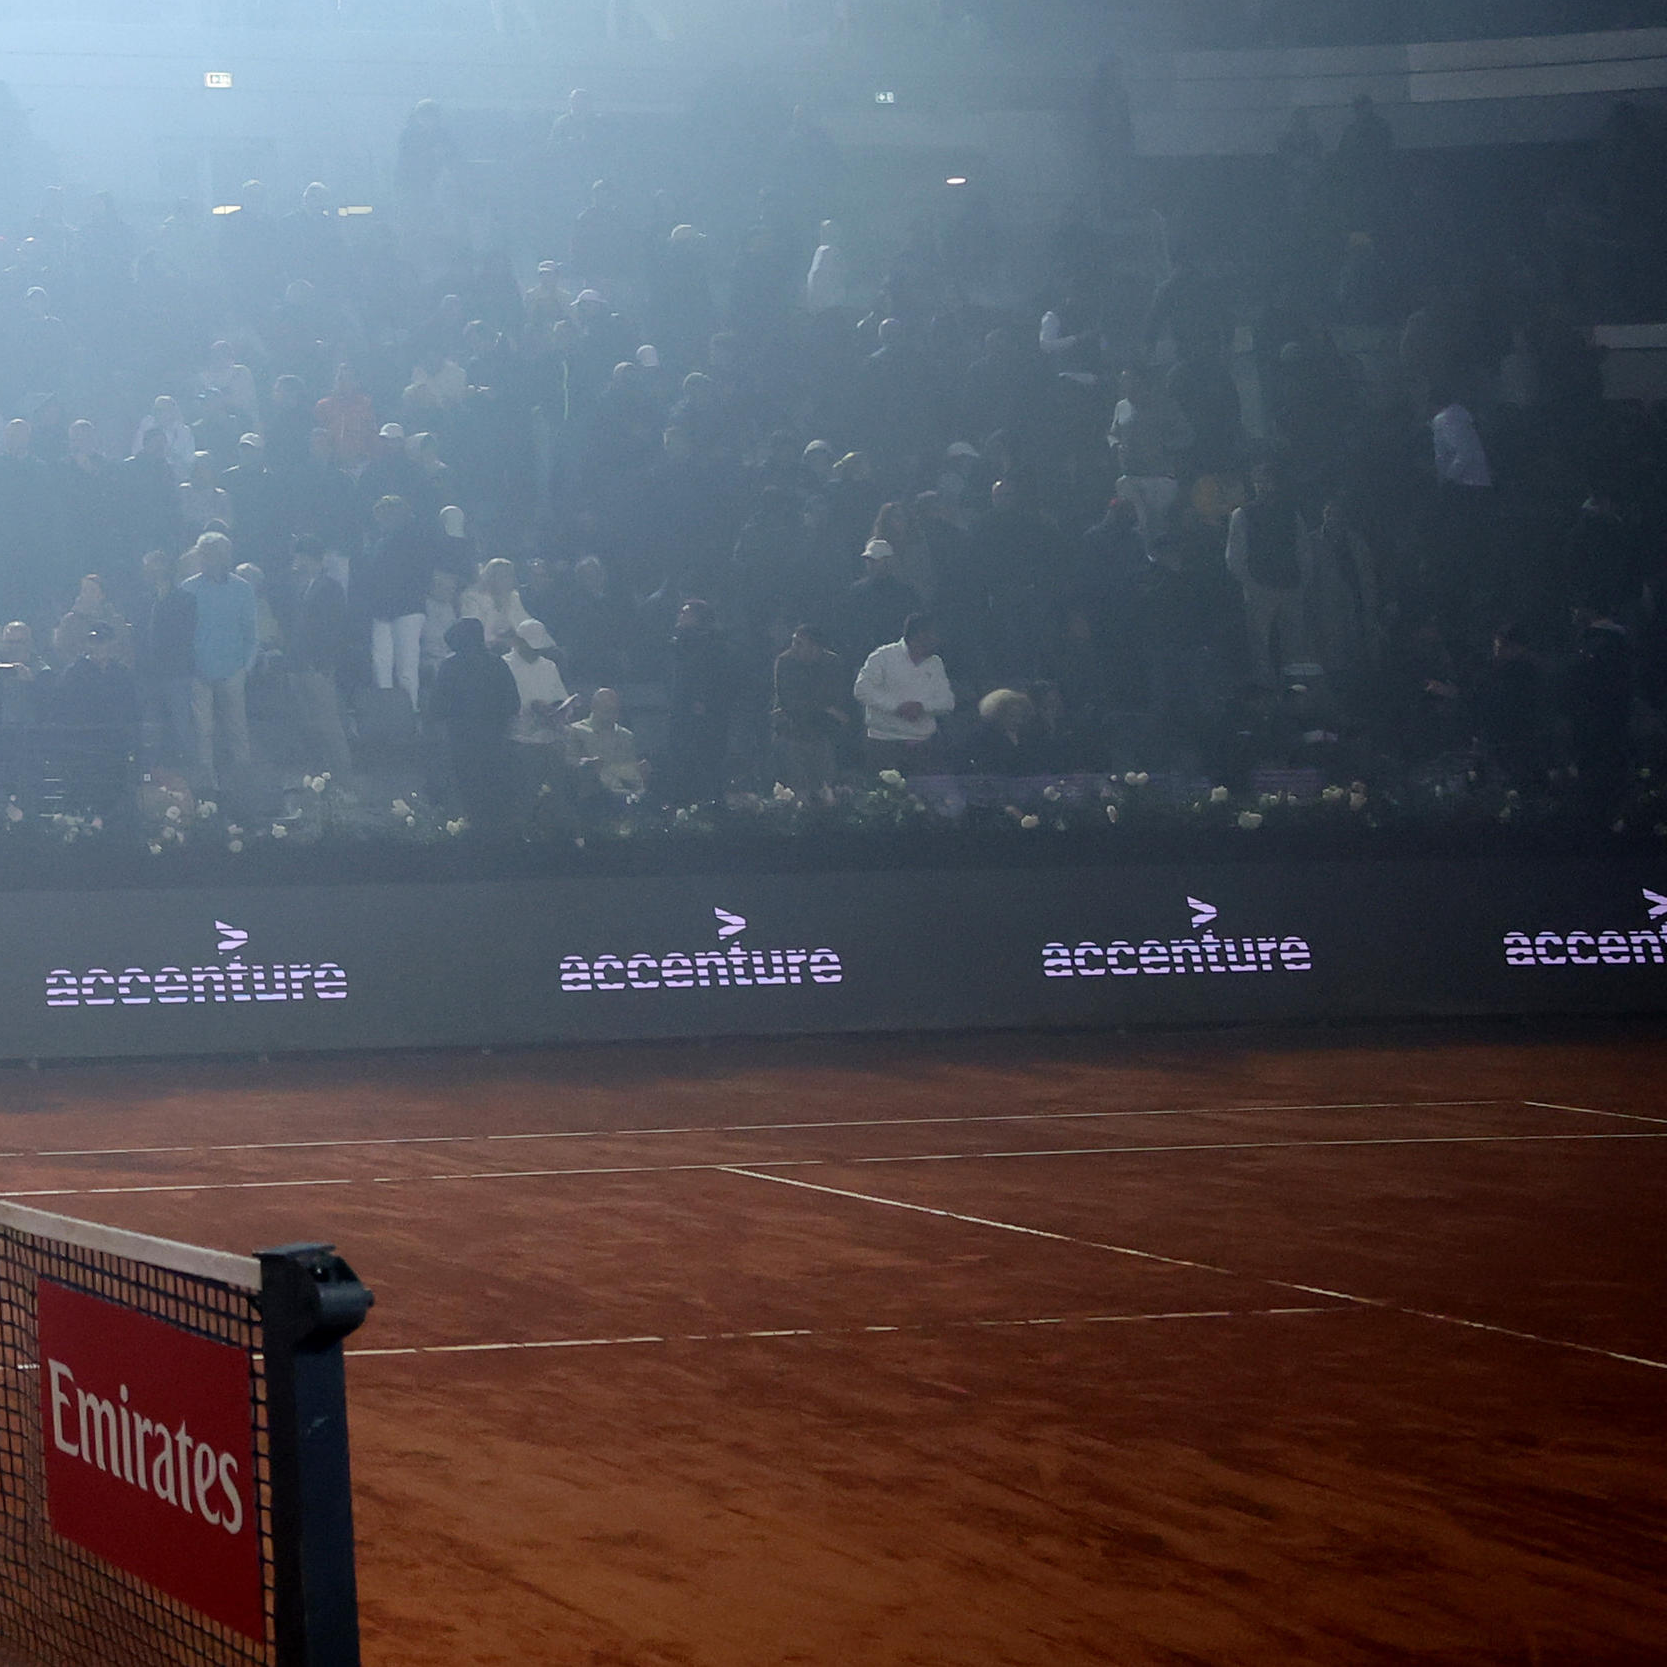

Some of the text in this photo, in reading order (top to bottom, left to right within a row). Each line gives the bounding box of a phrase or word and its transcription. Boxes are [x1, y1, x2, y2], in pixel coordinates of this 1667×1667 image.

[559, 938, 844, 992] accenture
[1041, 929, 1312, 979] accenture
[46, 955, 348, 1006] accenture
[47, 1356, 243, 1535] Emirates
